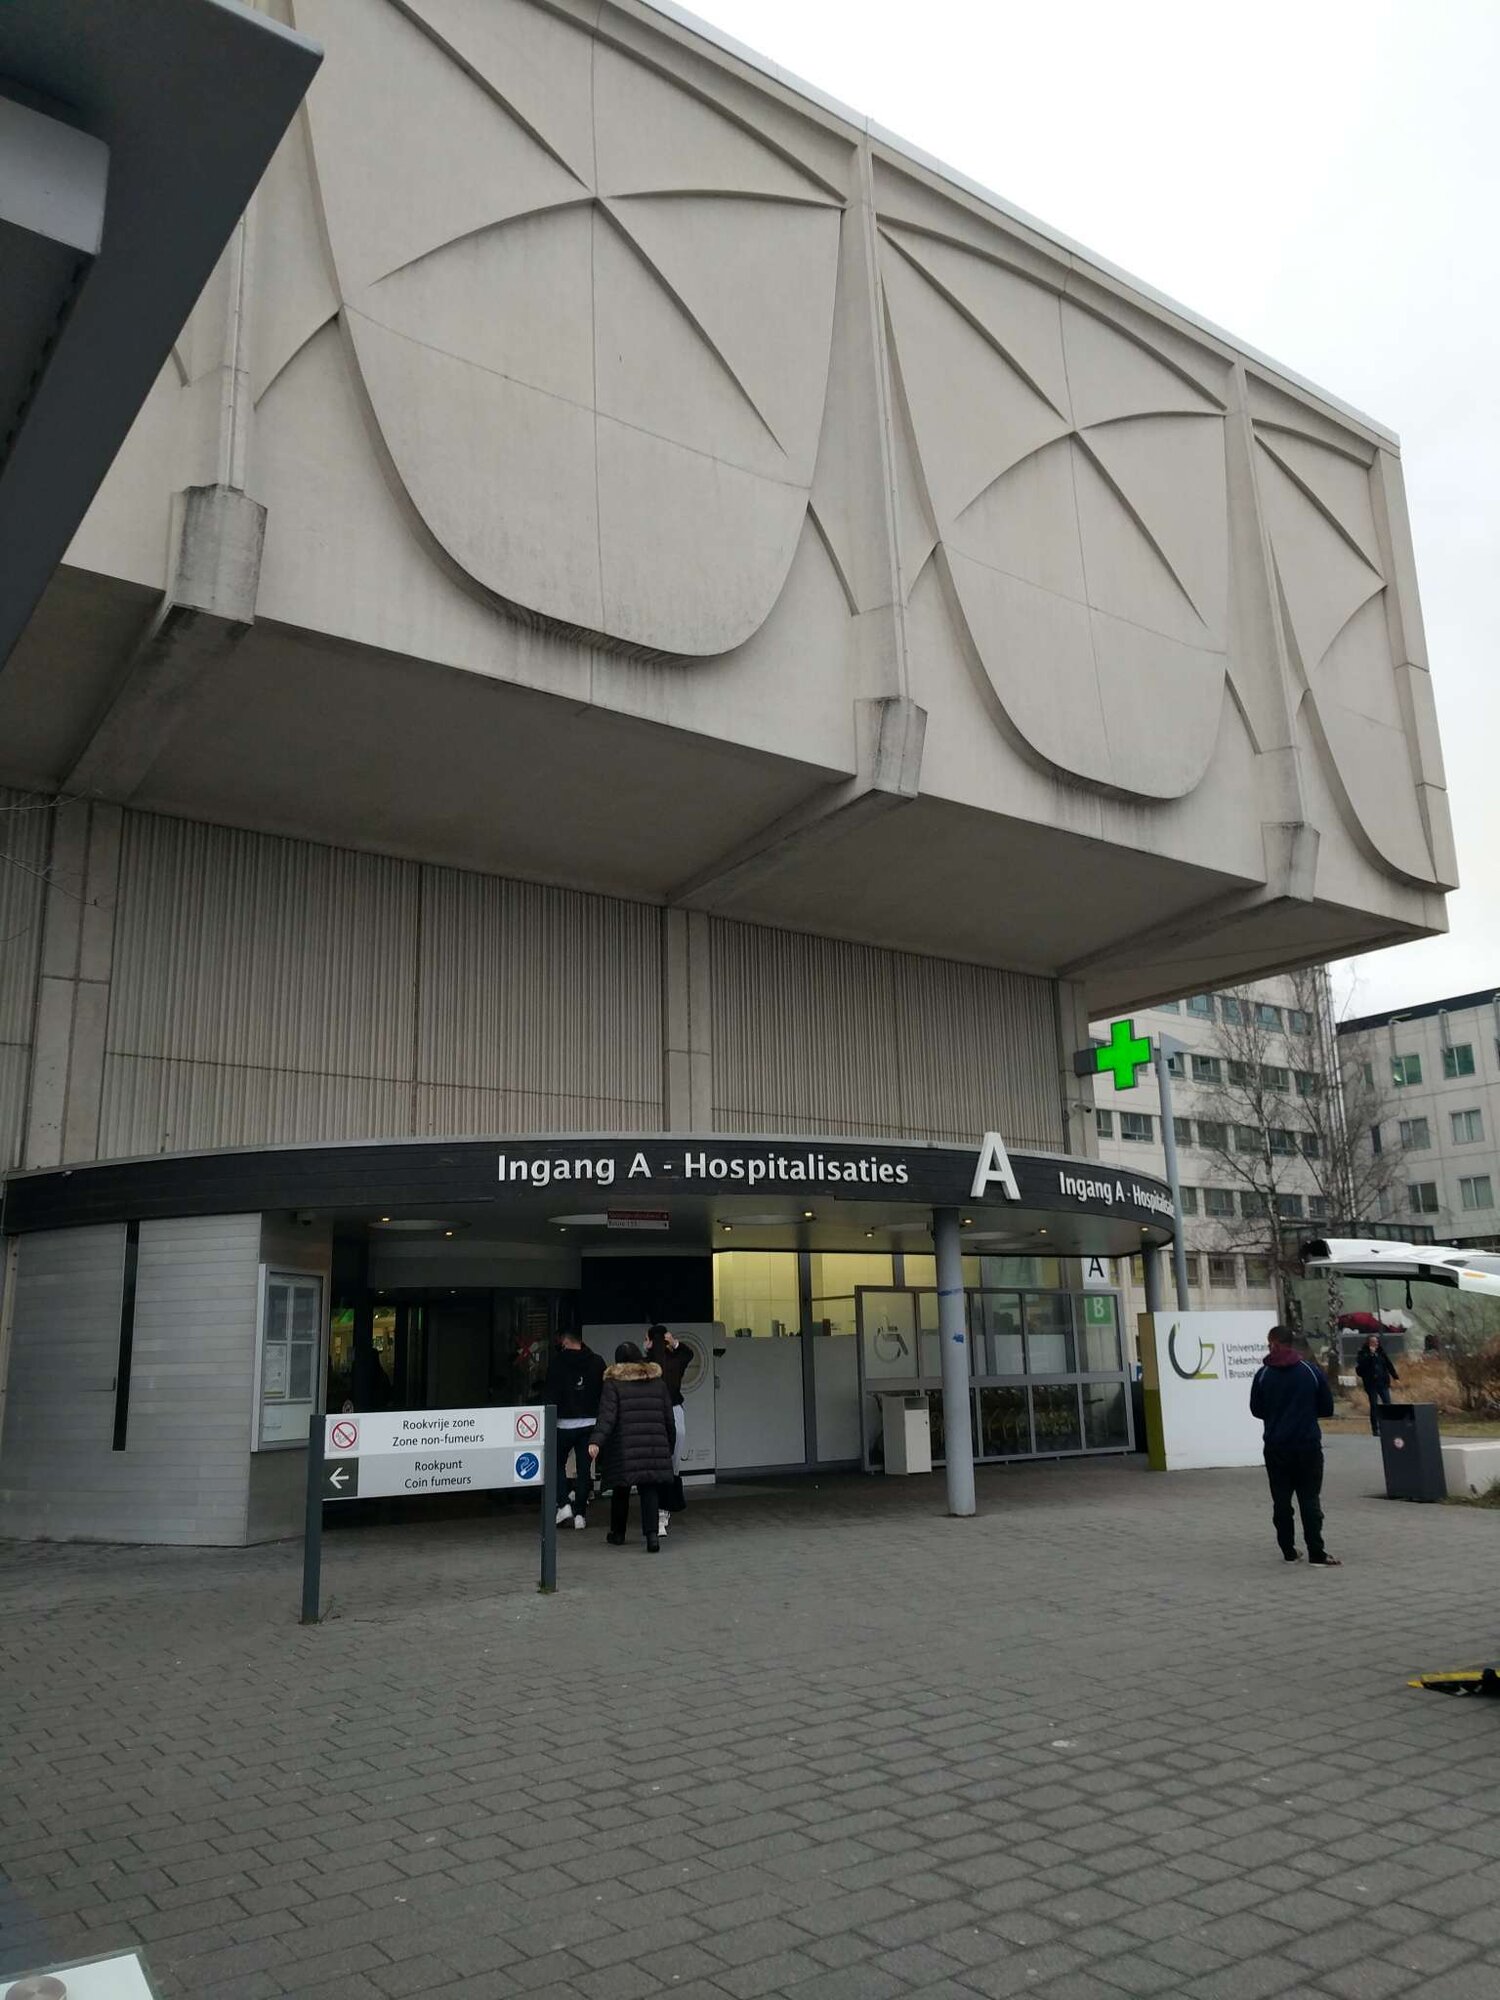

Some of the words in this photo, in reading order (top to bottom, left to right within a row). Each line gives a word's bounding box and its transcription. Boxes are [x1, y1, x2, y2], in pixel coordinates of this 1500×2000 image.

[498, 1155, 615, 1187] Ingang
[628, 1153, 652, 1178] A
[685, 1153, 909, 1185] Hospitalisaties
[970, 1131, 1022, 1200] A
[1059, 1171, 1113, 1205] Ingang
[1115, 1180, 1126, 1203] A
[1088, 1257, 1105, 1278] A
[1093, 1298, 1105, 1318] B
[1227, 1344, 1269, 1352] Universitai
[1228, 1356, 1263, 1365] Ziekenhu
[402, 1419, 449, 1431] Rookvrije
[452, 1418, 475, 1428] zone
[392, 1436, 418, 1447] Zone
[421, 1434, 485, 1445] non-fumeurs
[415, 1459, 463, 1472] Rookpunt
[404, 1478, 428, 1489] Coin
[431, 1476, 472, 1487] fumeurs
